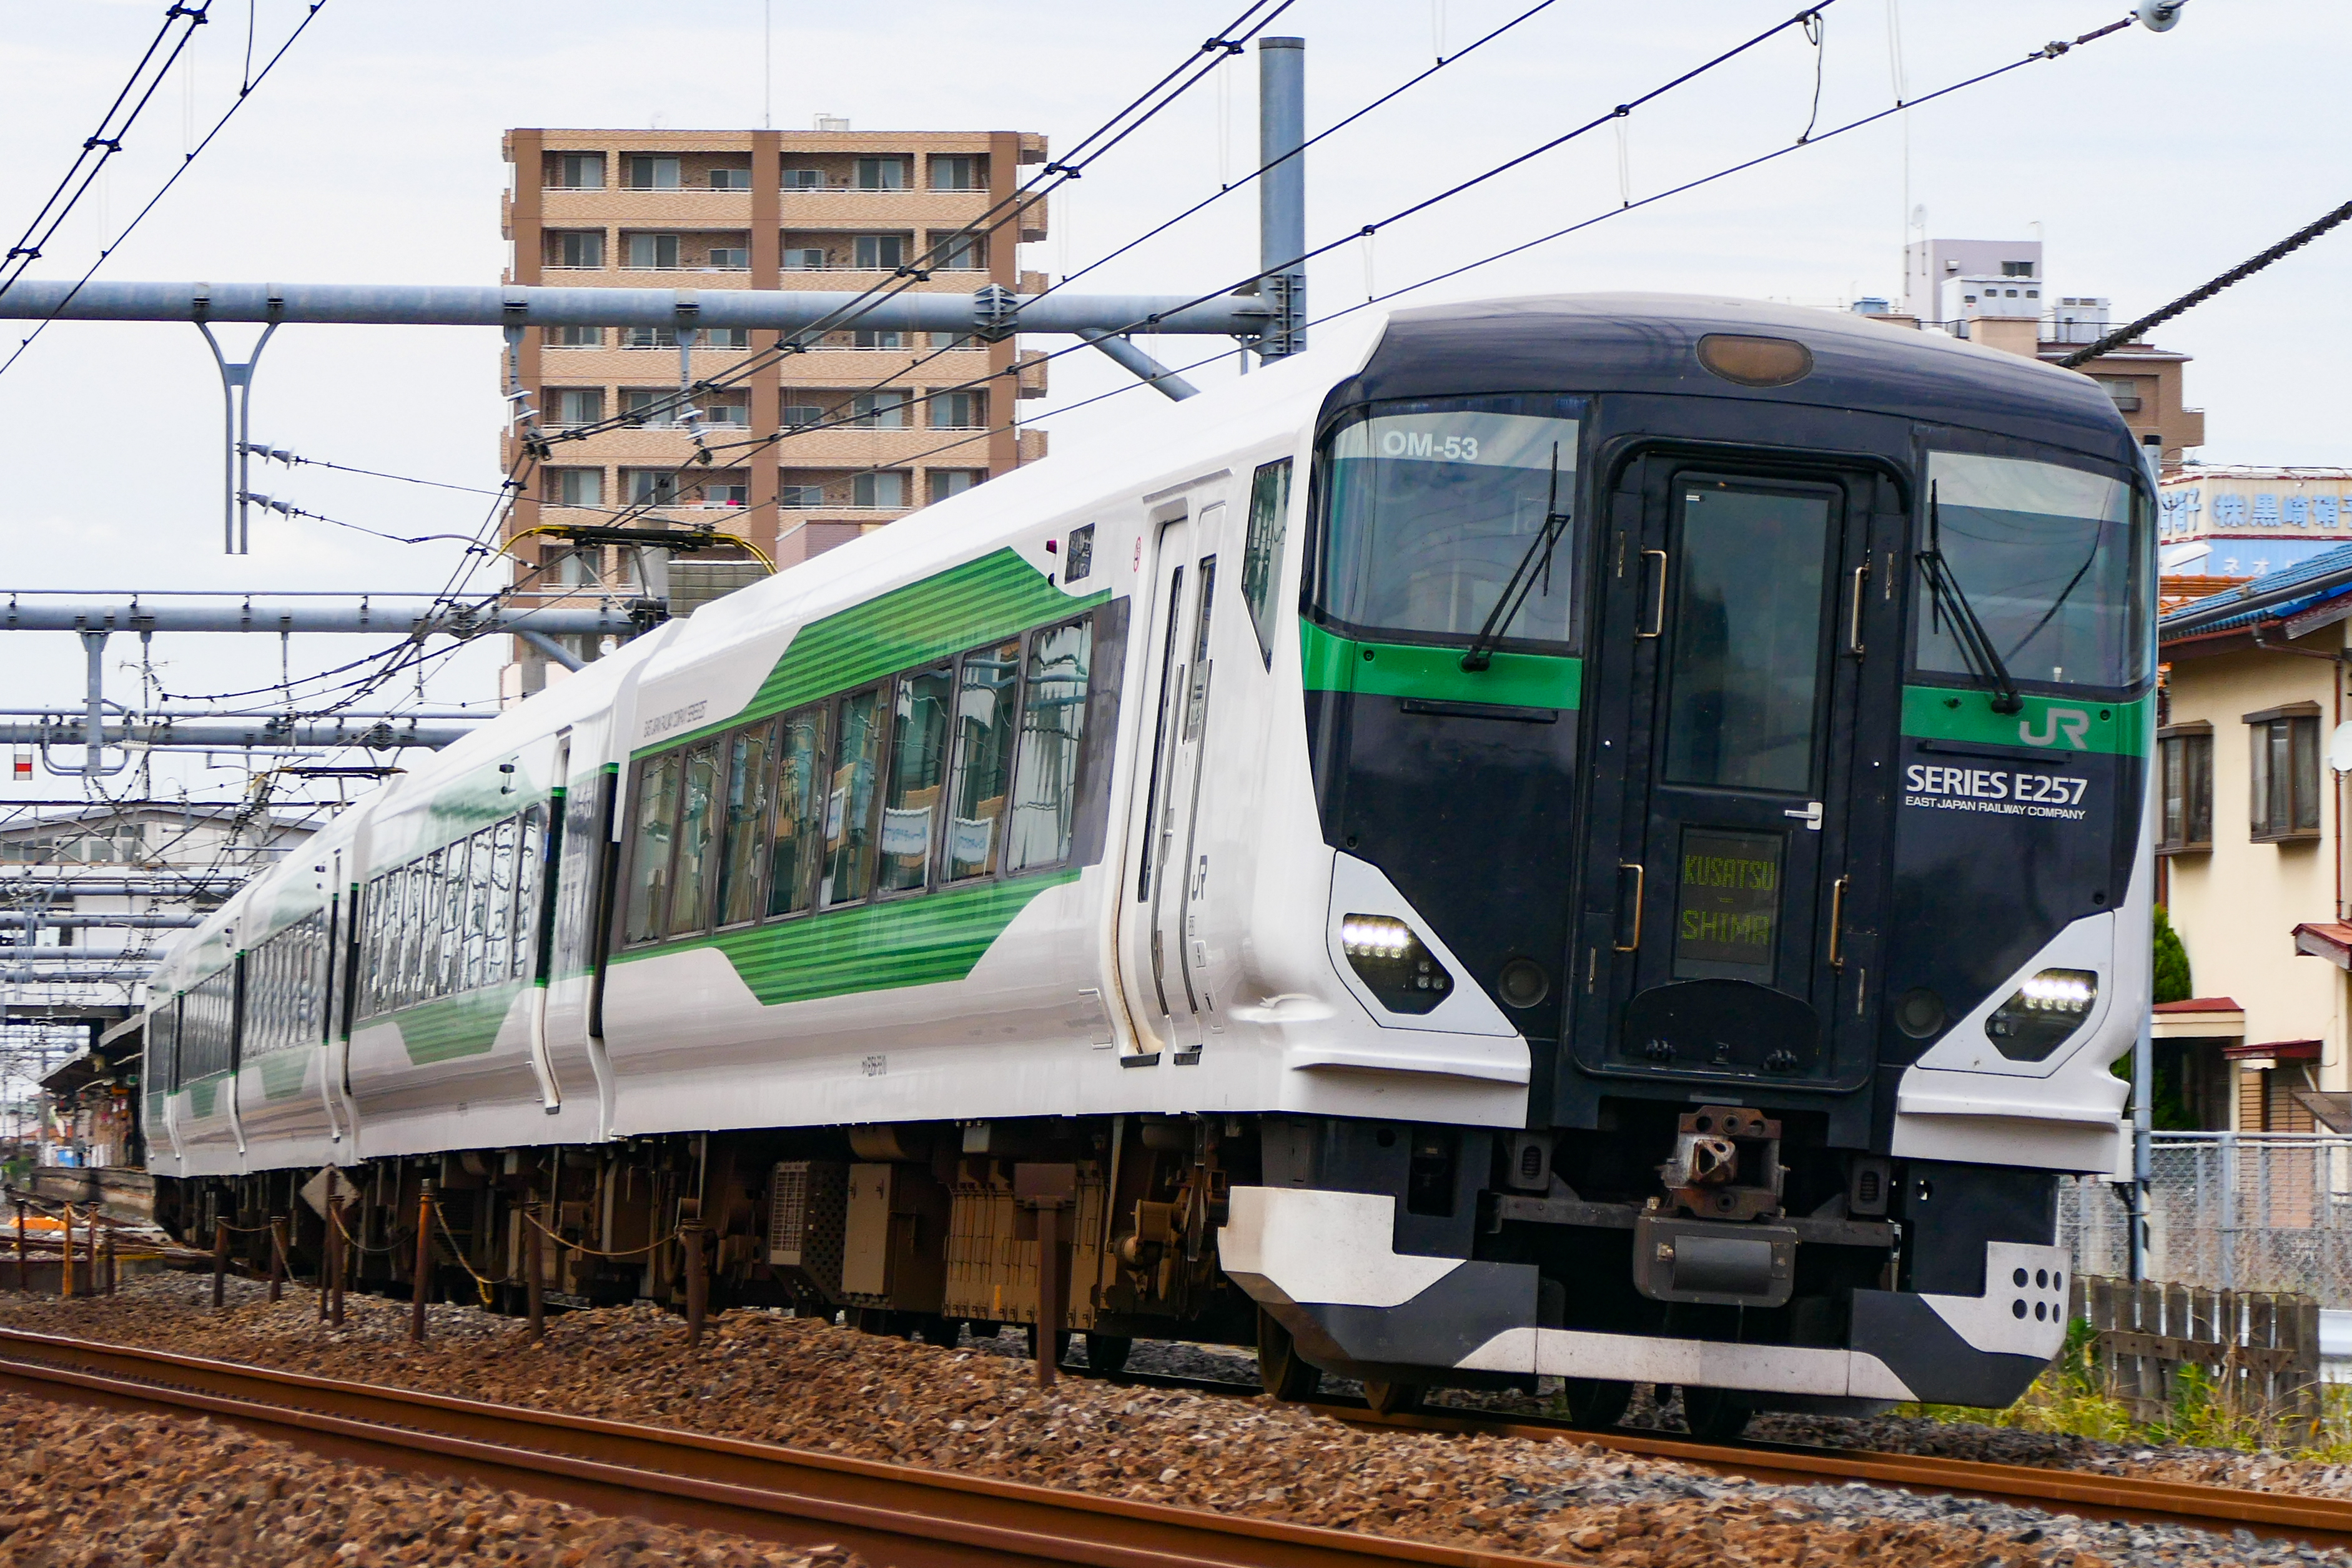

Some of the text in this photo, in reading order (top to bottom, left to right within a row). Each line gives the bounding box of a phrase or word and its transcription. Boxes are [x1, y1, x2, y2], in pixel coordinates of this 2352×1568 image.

[1383, 431, 1478, 460] OM-53
[2019, 708, 2090, 749] JR
[1906, 764, 2088, 806] SERIES E257
[1905, 796, 2086, 821] EAST JAPAN RAILWAY COMPANY
[1684, 855, 1775, 890] KUSATSU
[1682, 910, 1770, 945] SHIMA
